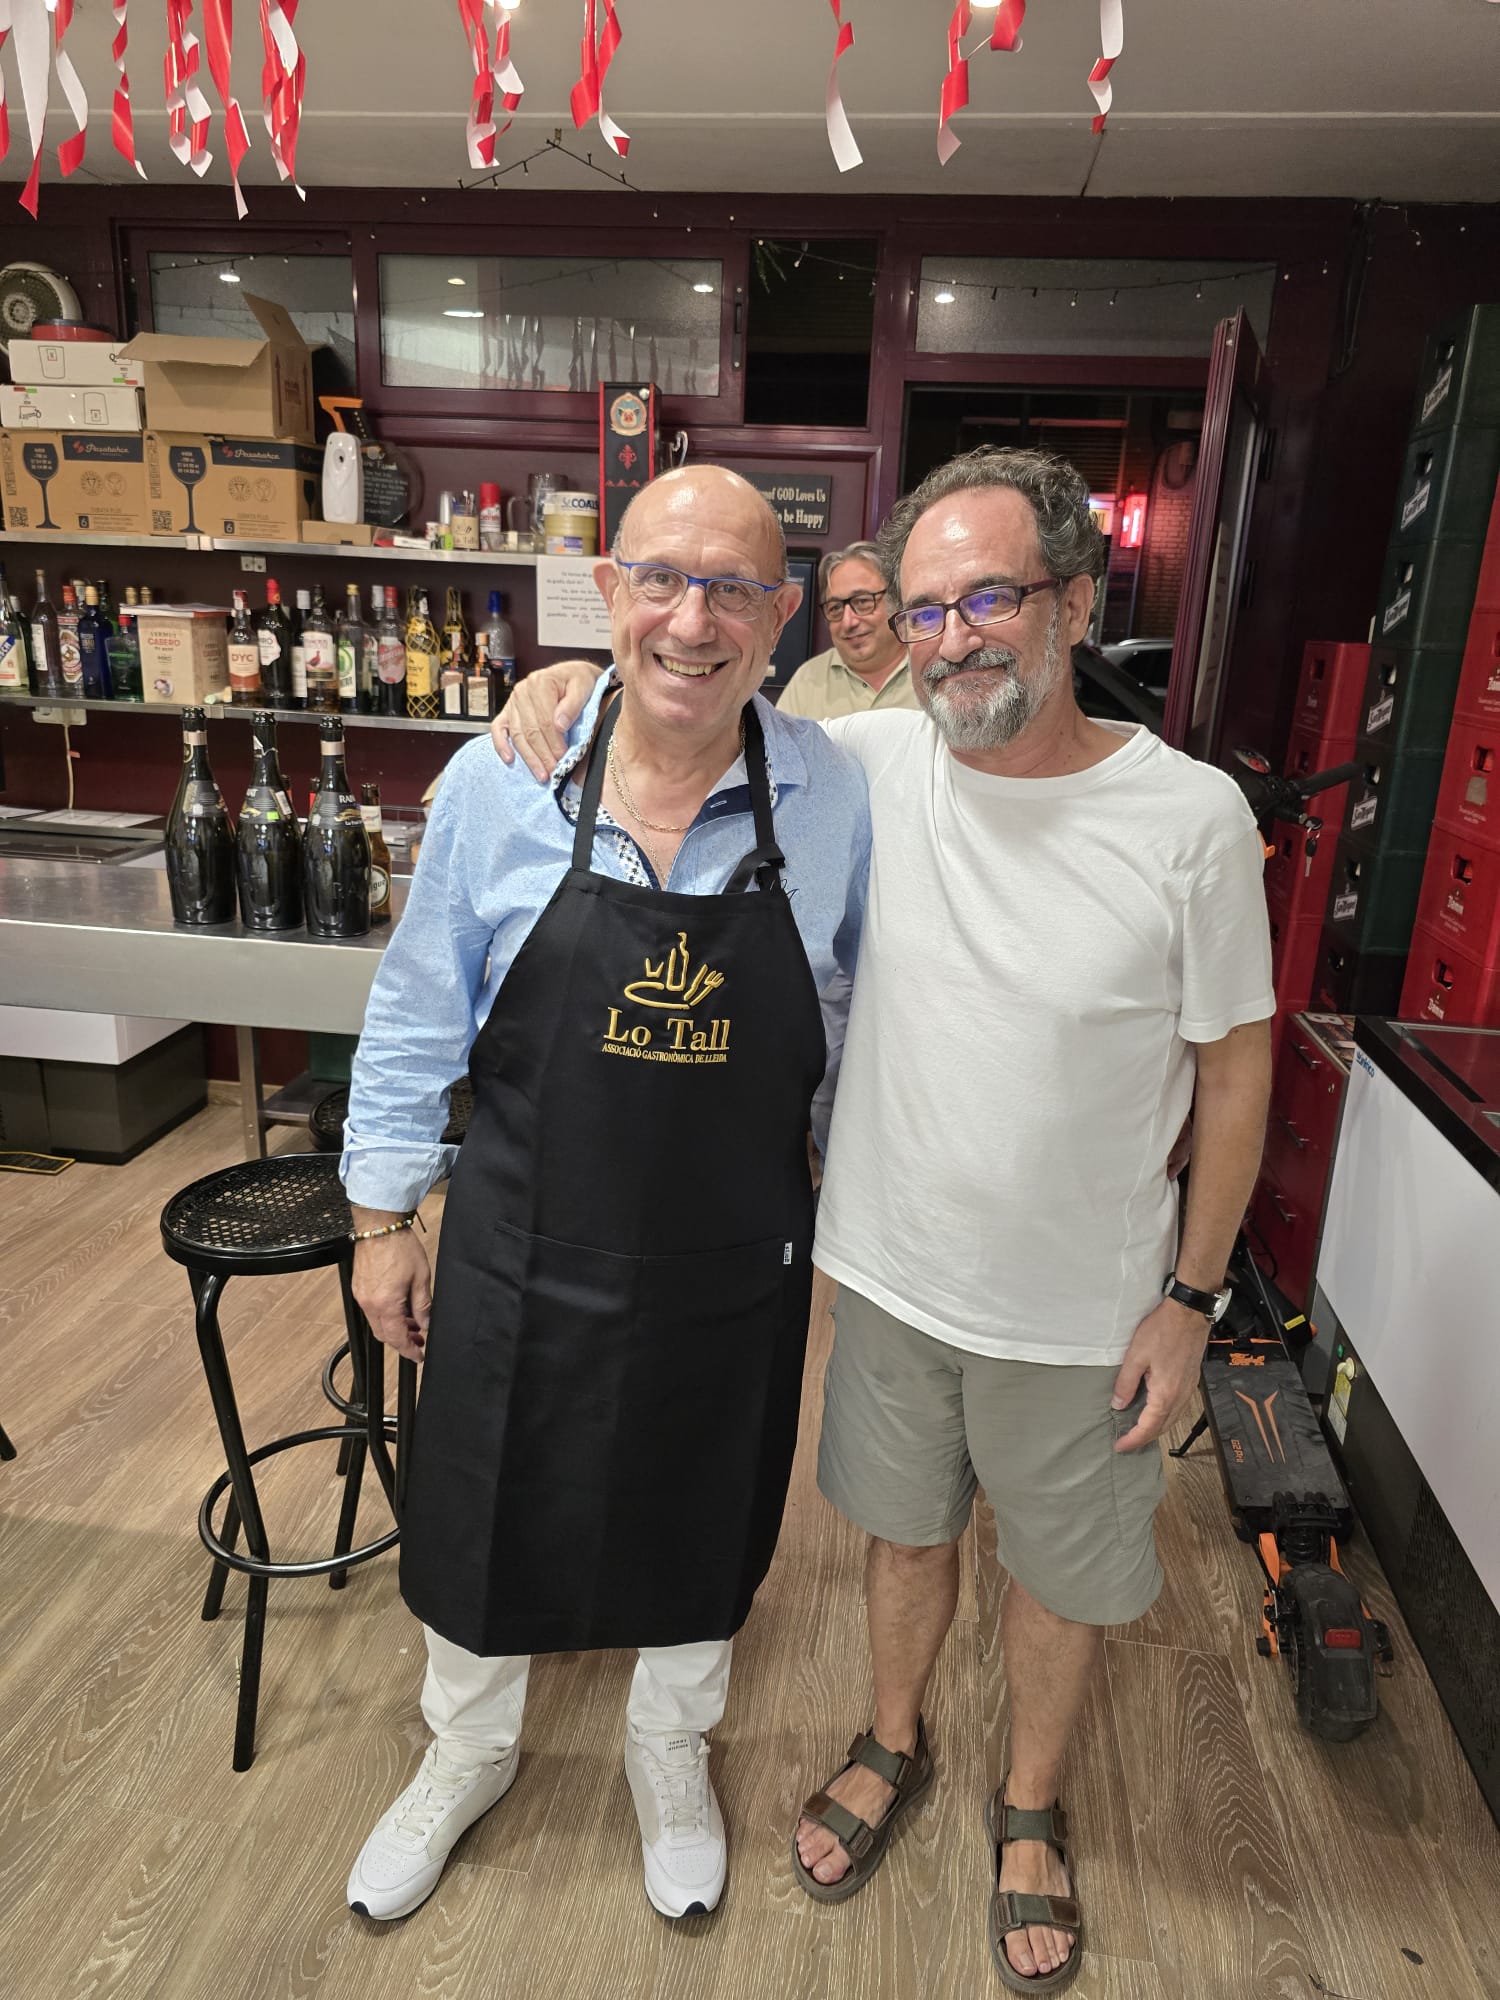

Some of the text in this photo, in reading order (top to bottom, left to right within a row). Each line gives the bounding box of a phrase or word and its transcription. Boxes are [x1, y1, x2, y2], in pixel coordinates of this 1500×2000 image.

[777, 487, 795, 501] GOD
[795, 488, 815, 502] Loves
[816, 488, 826, 503] Us
[80, 517, 88, 527] 6
[784, 508, 794, 524] be
[795, 508, 824, 529] Happy
[226, 523, 233, 533] 6
[231, 653, 254, 662] DYC
[603, 1006, 731, 1051] Lo Tall
[601, 1042, 642, 1058] ASSOCIACIÓ
[694, 1054, 705, 1064] DE
[704, 1053, 728, 1063] LLEIDA
